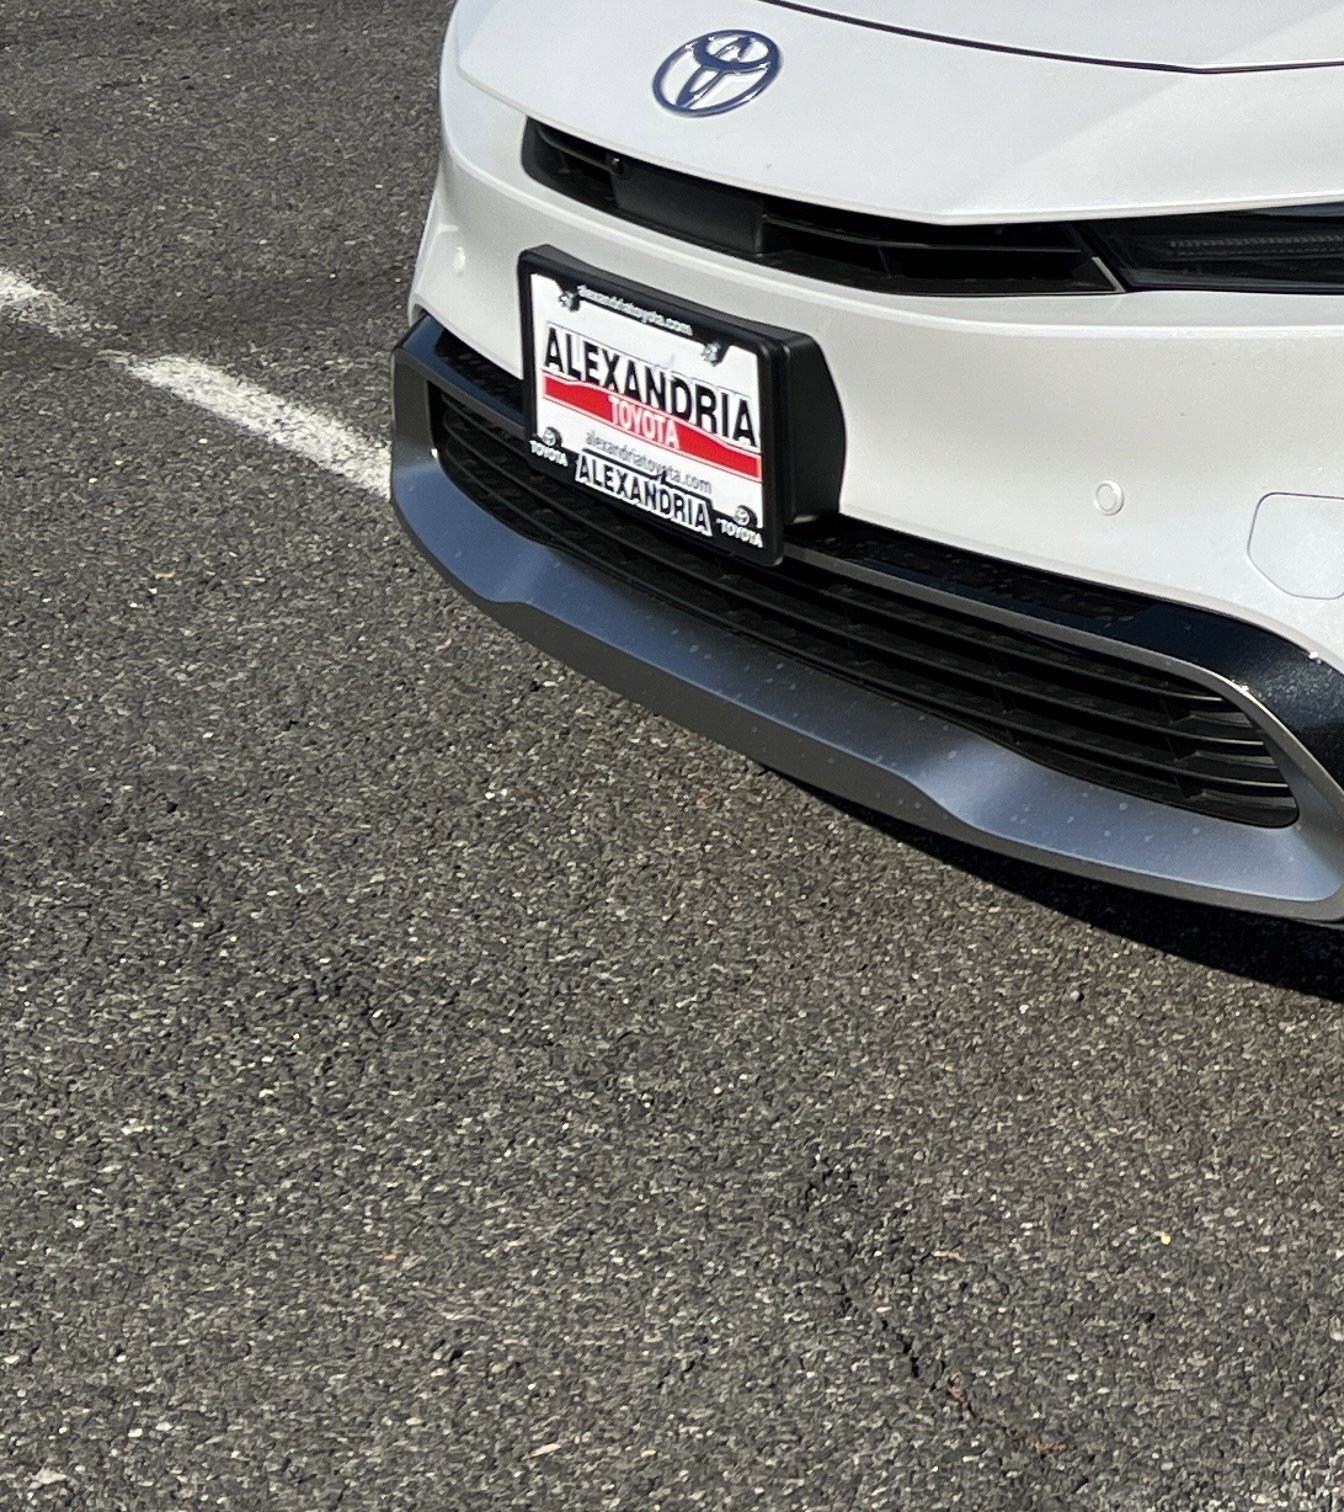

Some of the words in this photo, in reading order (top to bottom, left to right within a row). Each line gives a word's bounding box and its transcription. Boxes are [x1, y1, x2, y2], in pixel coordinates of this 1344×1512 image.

[544, 326, 758, 448] ALEXANDRIA
[607, 393, 681, 451] TOYOTA
[577, 451, 711, 536] ALEXANDRIA
[715, 517, 765, 549] TOYOTA
